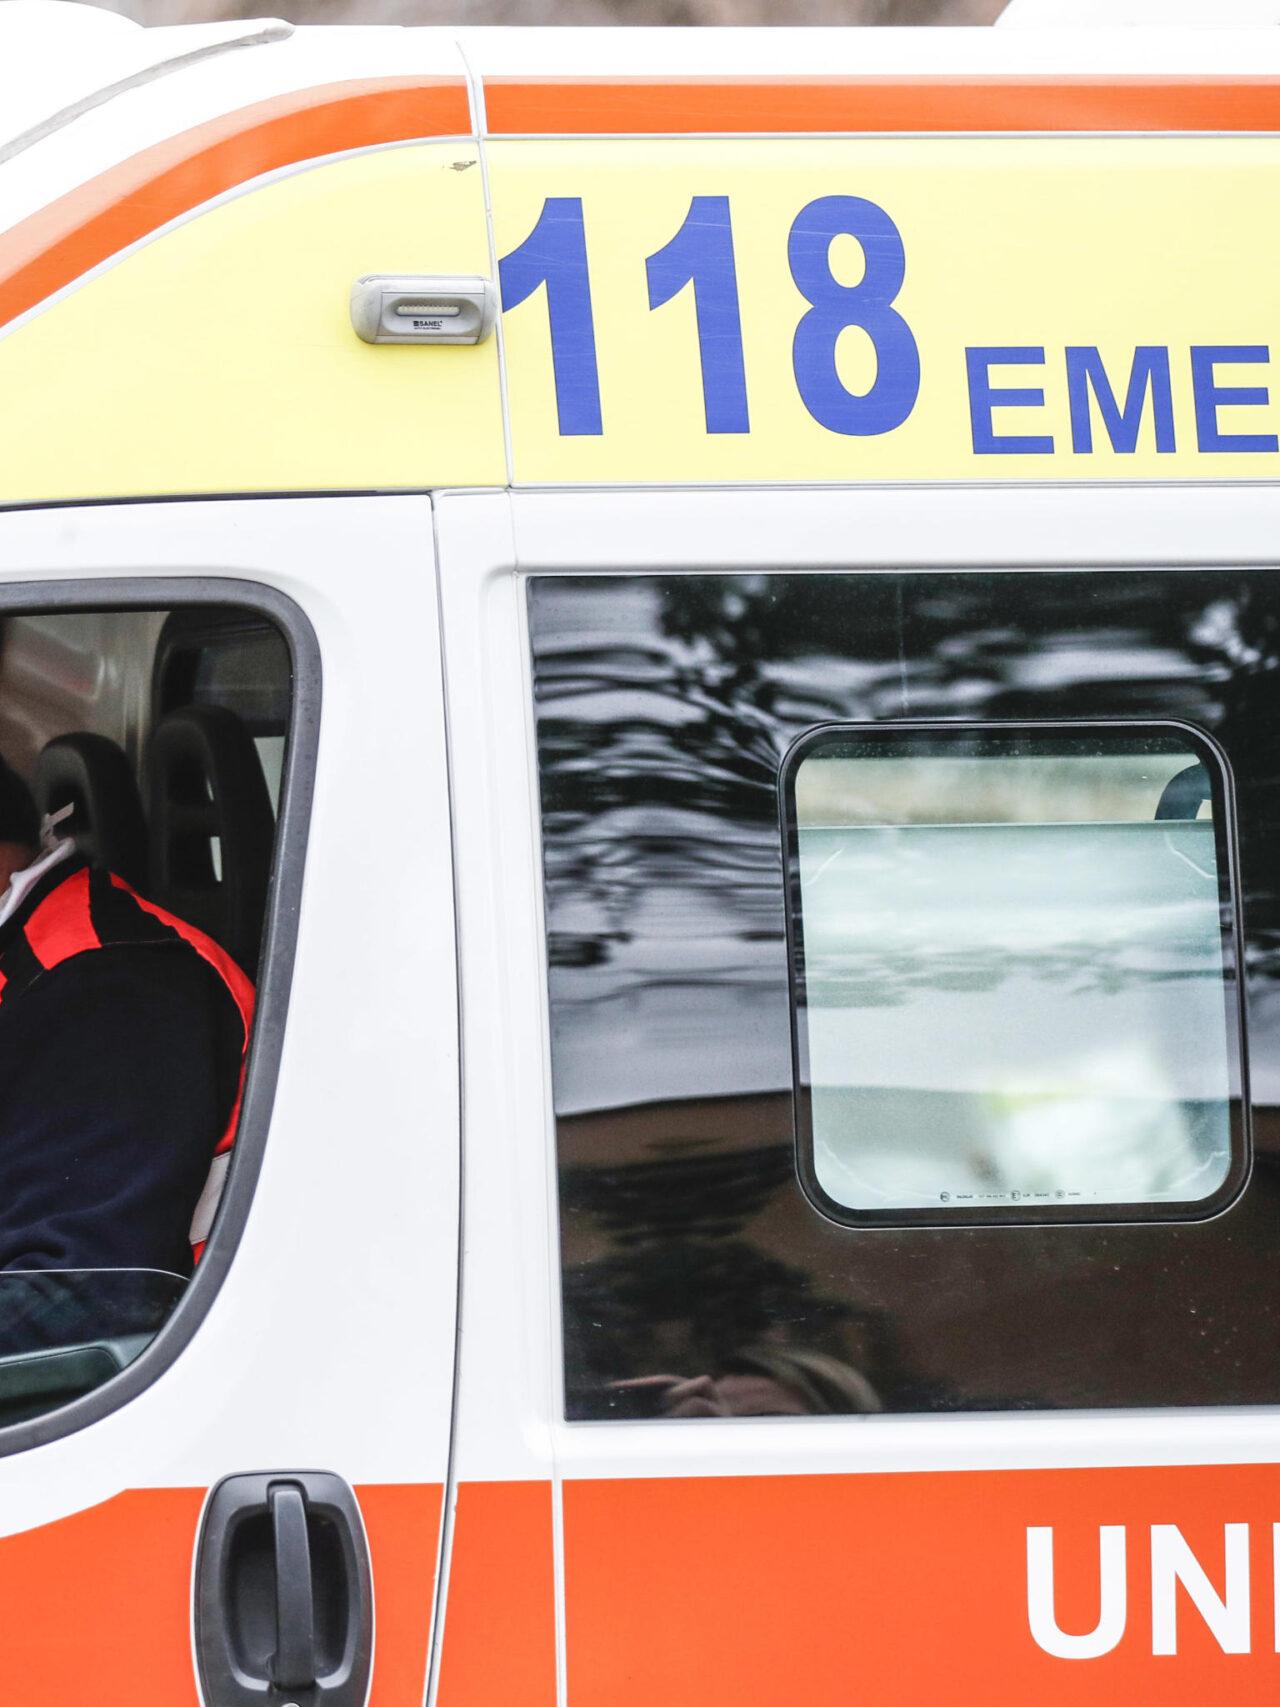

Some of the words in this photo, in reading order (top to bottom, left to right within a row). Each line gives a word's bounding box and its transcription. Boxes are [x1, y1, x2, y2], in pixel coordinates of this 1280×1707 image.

[498, 195, 921, 436] 118
[965, 345, 1280, 455] EME
[1026, 1522, 1280, 1660] UN
